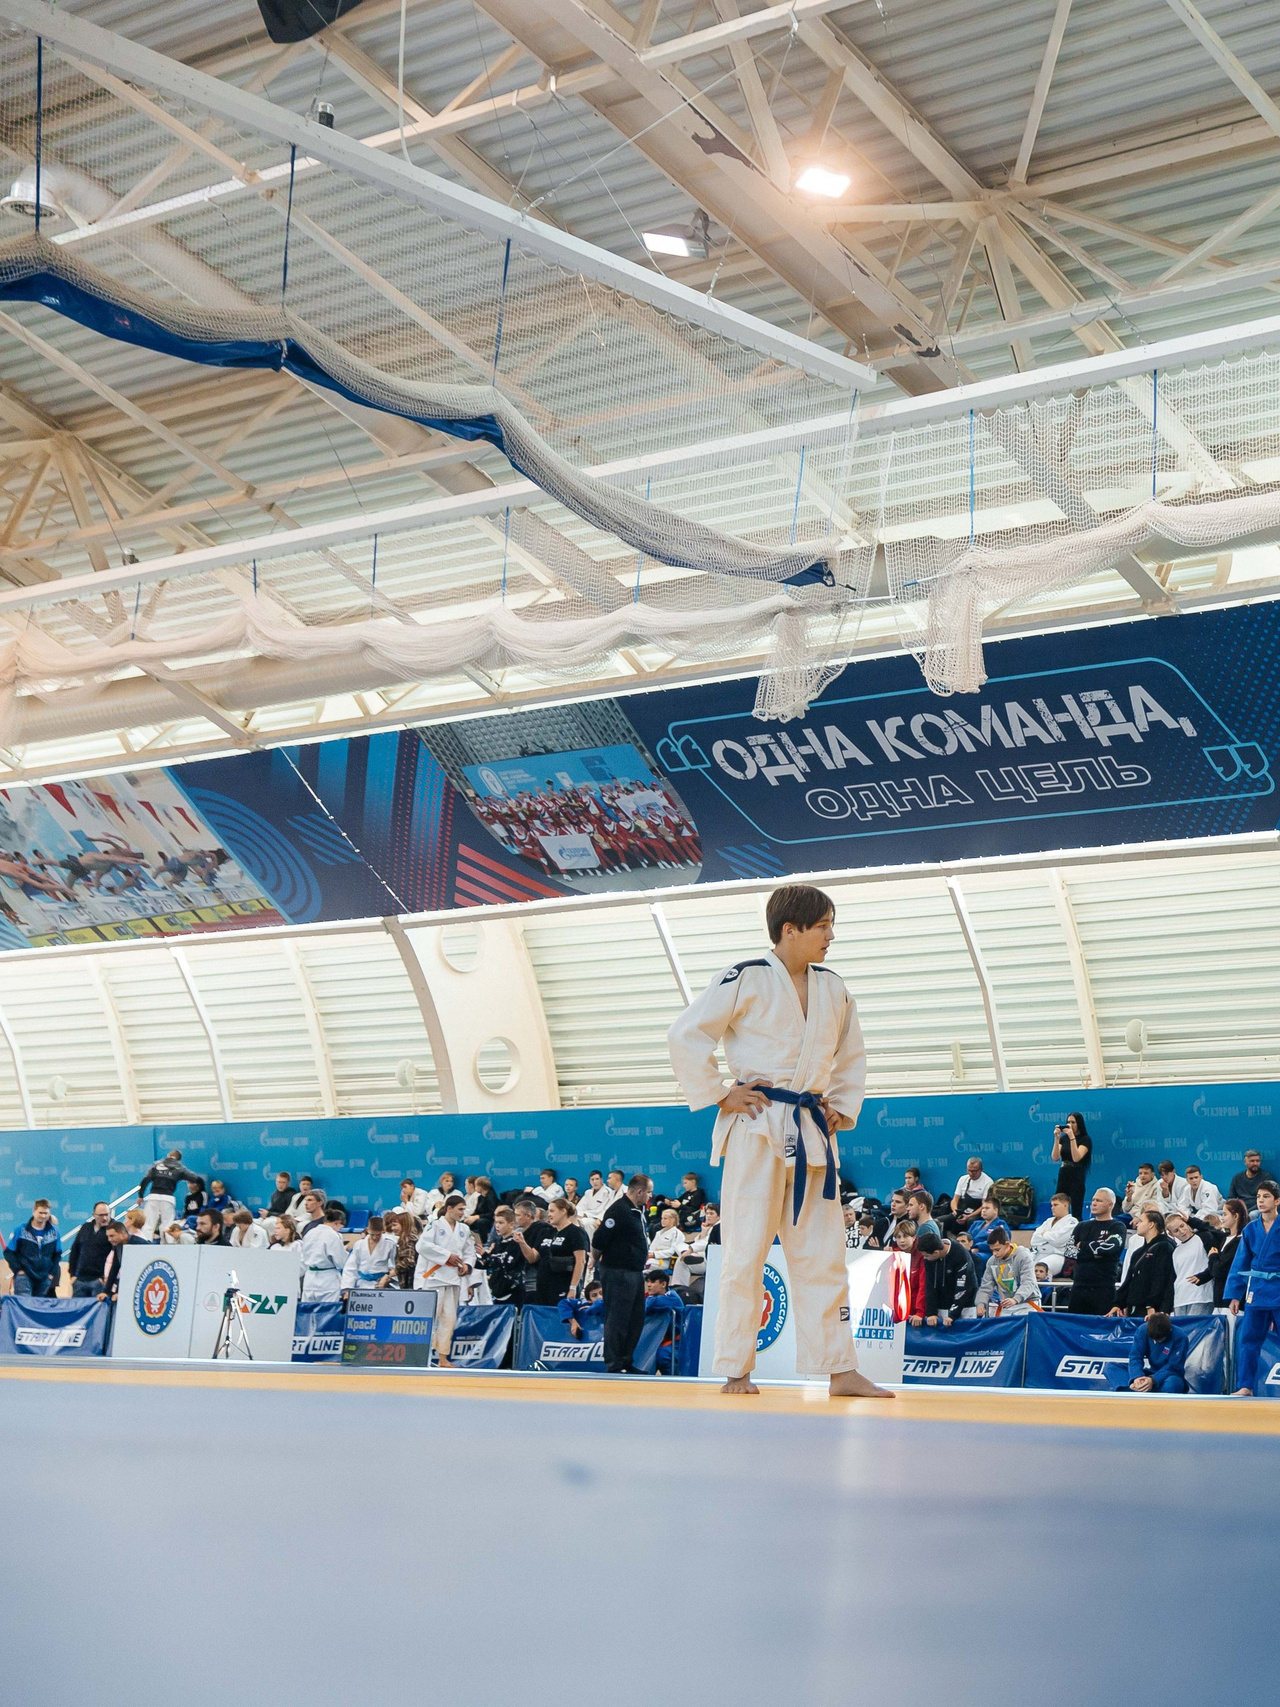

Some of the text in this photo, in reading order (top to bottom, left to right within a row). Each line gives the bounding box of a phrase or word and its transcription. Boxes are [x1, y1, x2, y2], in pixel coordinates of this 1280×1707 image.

[712, 685, 1198, 786] ОДНА КОМАНДА,
[805, 755, 1151, 821] ОДНА ЦЕЛЬ
[349, 1301, 373, 1312] Кеме
[763, 1266, 787, 1333] ЮДО РОССИИ
[404, 1300, 415, 1314] 0
[347, 1318, 376, 1332] КрасЯ
[391, 1320, 428, 1335] ИППОН
[858, 1329, 894, 1339] АНСГАЗ
[312, 1340, 341, 1351] LINE
[543, 1345, 590, 1358] START
[855, 1340, 894, 1350] ОМСК
[365, 1343, 406, 1362] 2:20
[903, 1359, 998, 1374] TART LINE
[1061, 1360, 1104, 1374] STA
